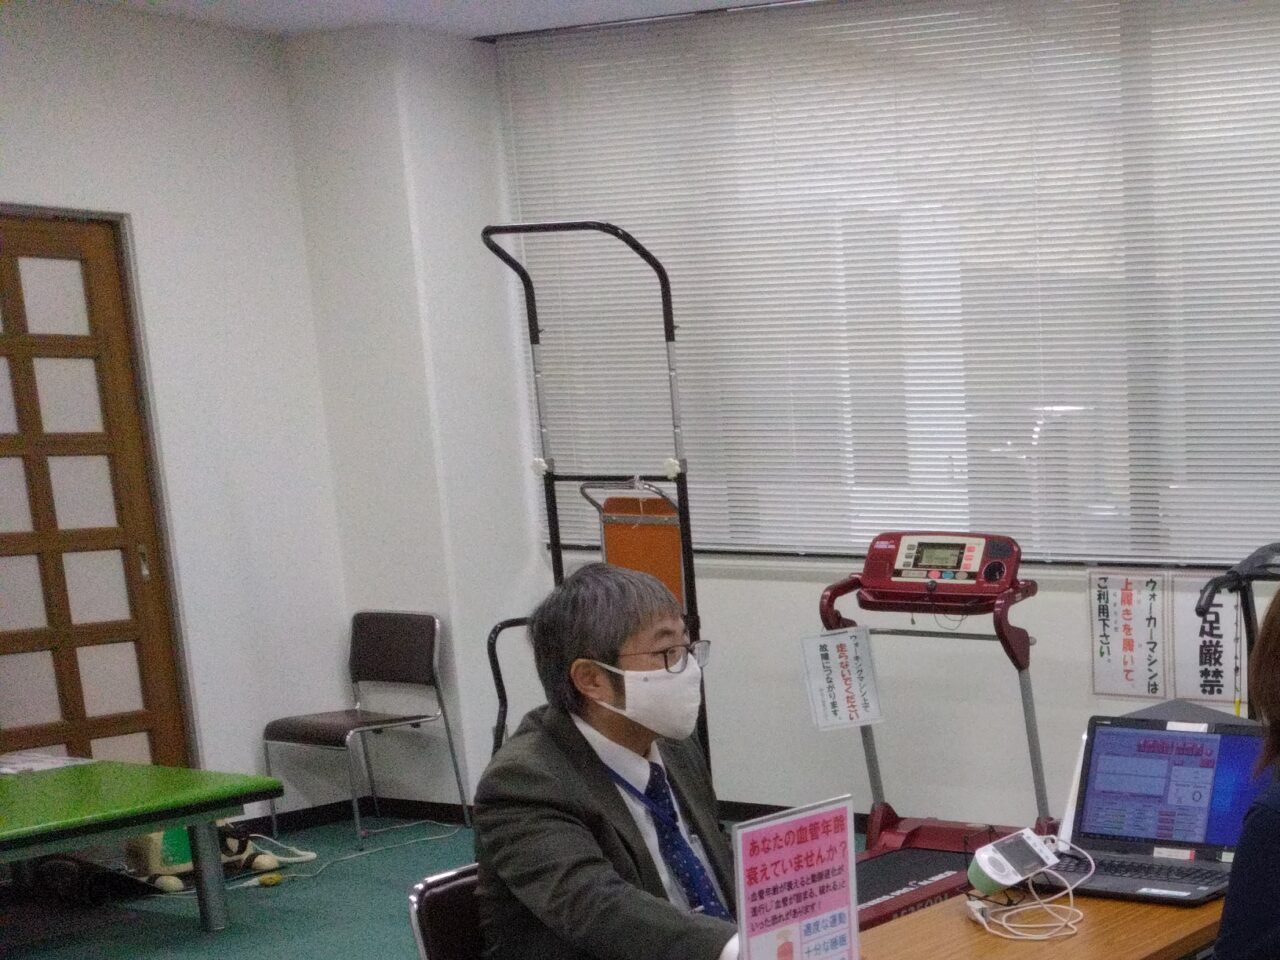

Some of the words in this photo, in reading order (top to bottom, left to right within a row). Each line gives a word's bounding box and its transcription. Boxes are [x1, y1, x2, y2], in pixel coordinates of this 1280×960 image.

[1145, 578, 1159, 694] ウォーカーマシンは
[749, 815, 845, 857] あなたの血管年齢
